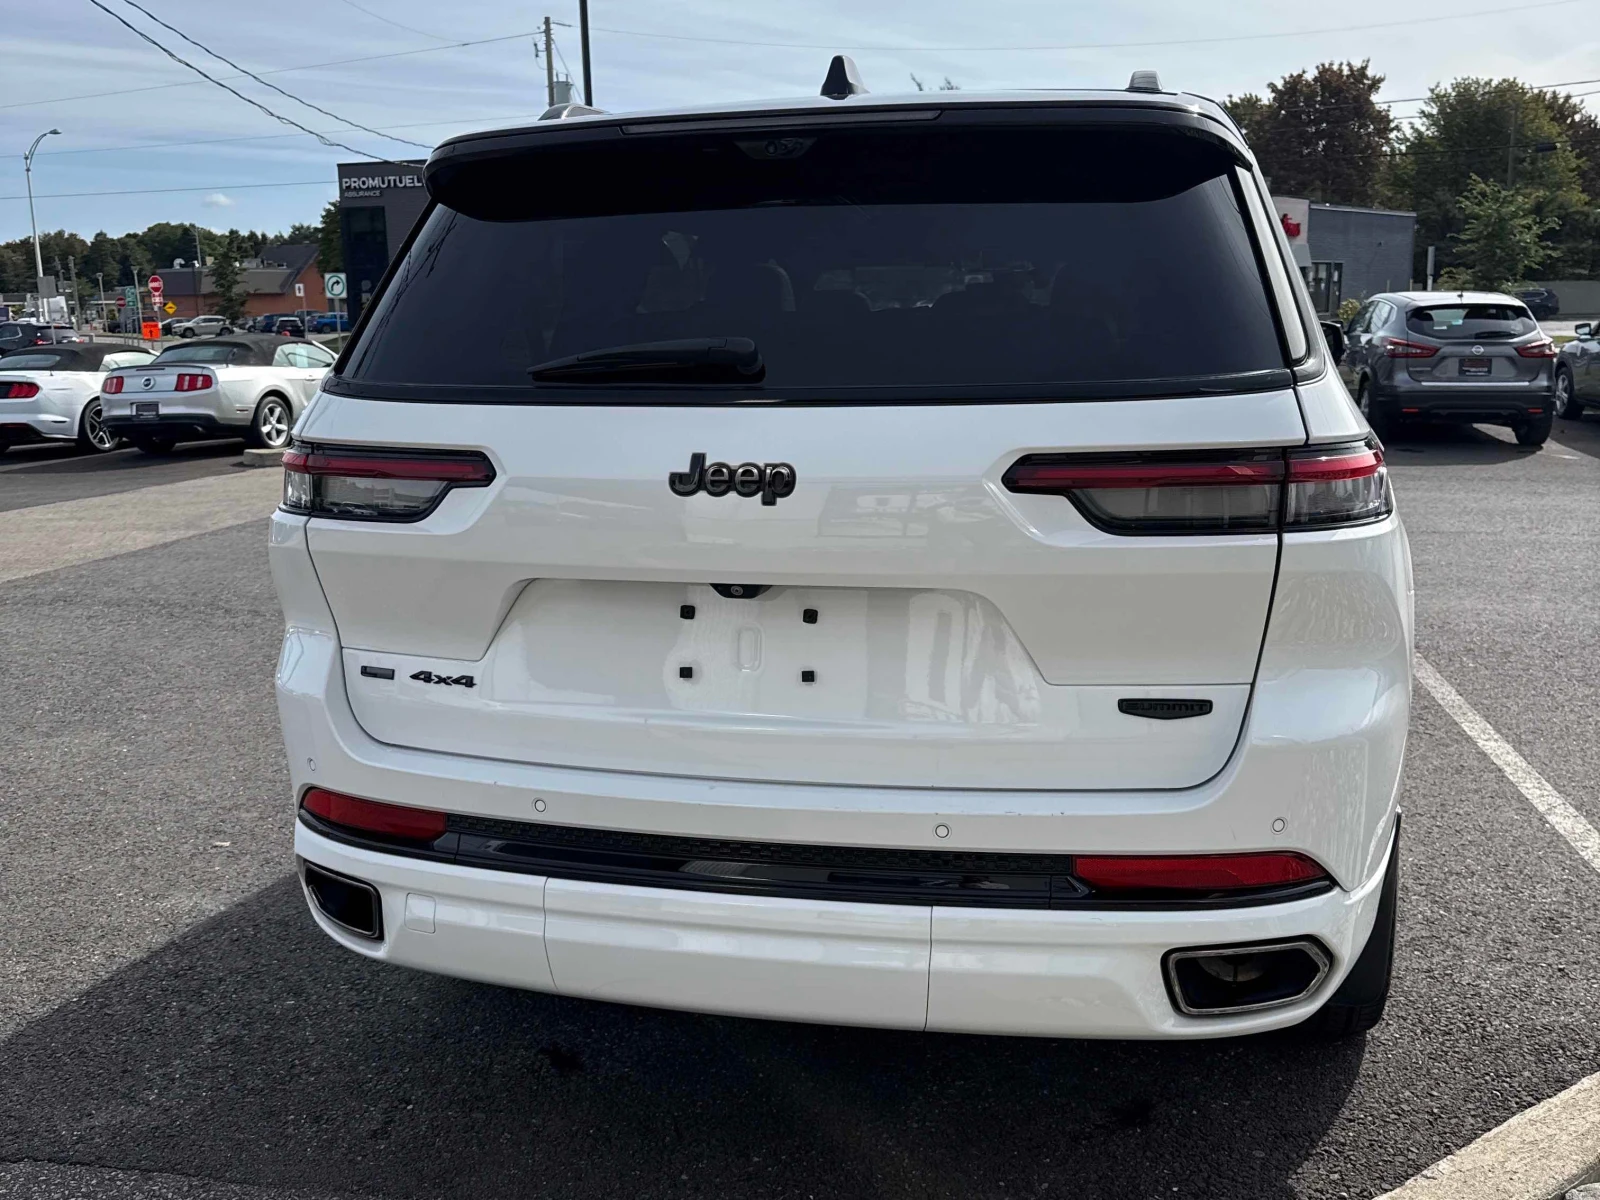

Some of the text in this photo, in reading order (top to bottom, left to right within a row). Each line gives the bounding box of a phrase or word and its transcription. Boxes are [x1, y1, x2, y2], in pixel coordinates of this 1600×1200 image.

[342, 175, 422, 190] PROMUTUEL
[344, 190, 380, 198] ASSURANCE
[668, 452, 797, 506] Jeep
